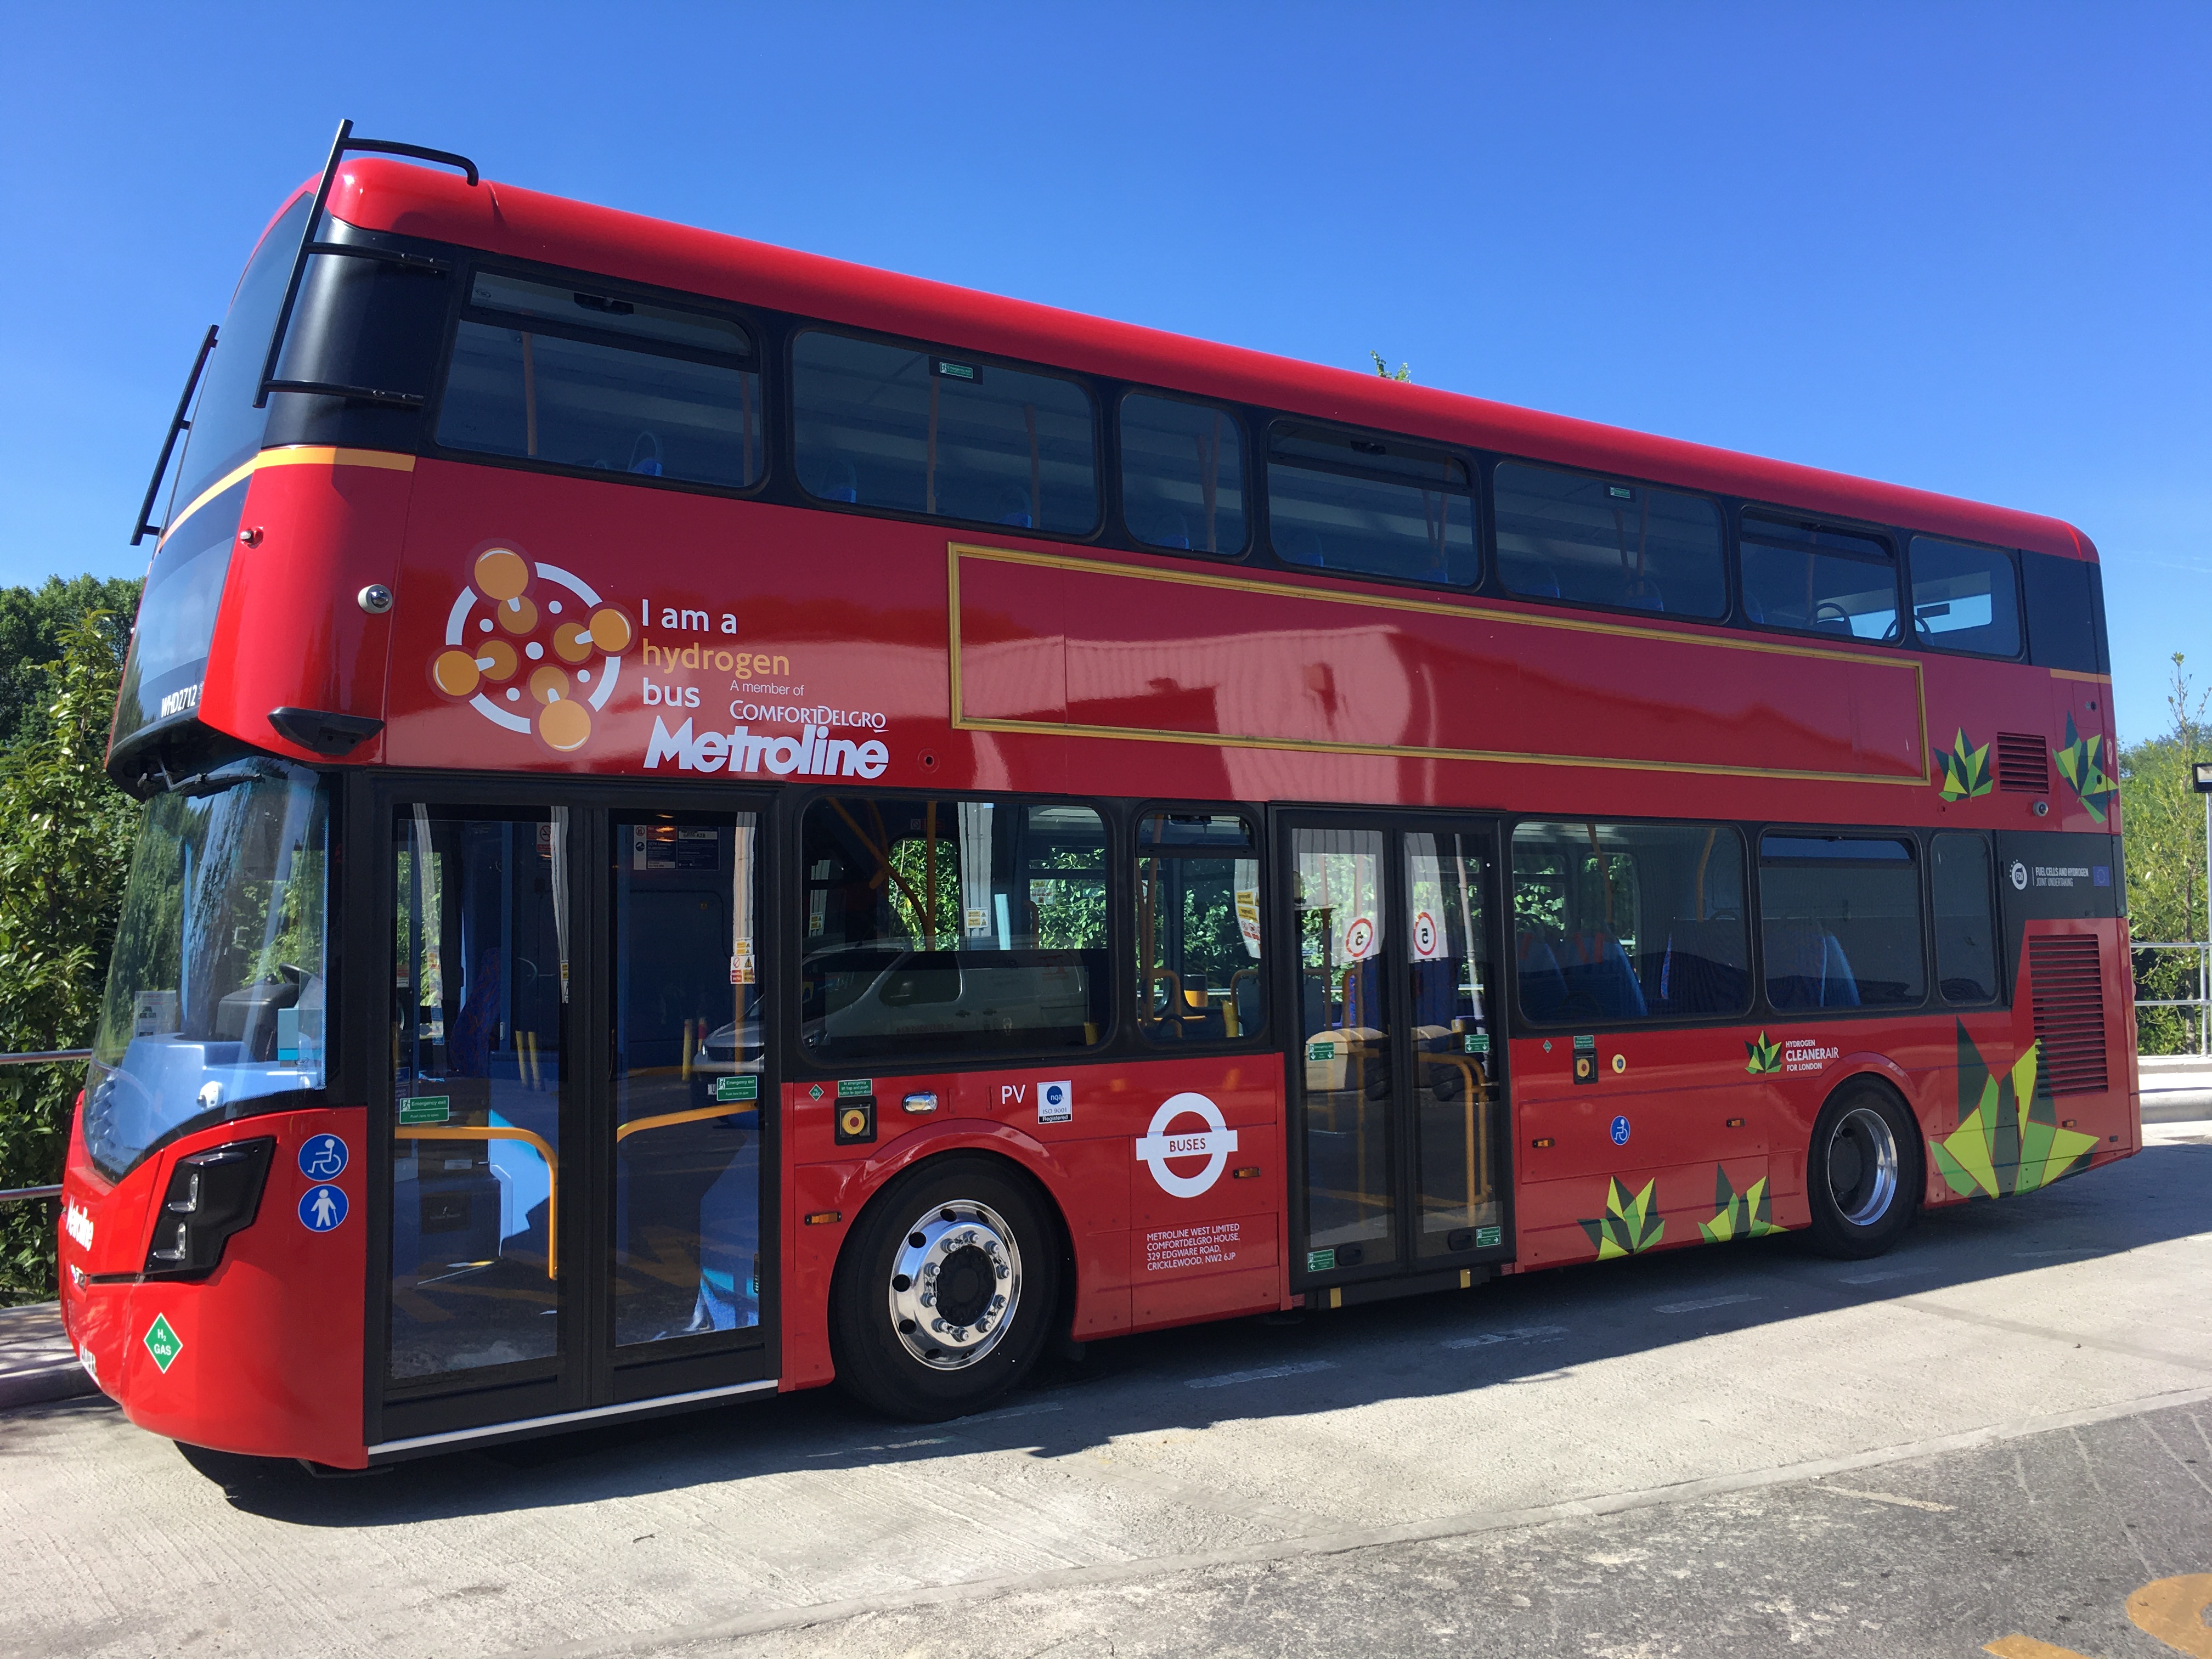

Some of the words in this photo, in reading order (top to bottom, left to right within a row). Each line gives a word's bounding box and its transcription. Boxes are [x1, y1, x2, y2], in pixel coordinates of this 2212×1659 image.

[642, 599, 649, 627] I
[661, 608, 709, 631] am
[721, 613, 737, 634] a
[642, 637, 790, 680] hydrogen
[643, 677, 701, 708] bus
[730, 680, 740, 692] A
[742, 682, 791, 696] member
[793, 685, 805, 696] of
[161, 684, 198, 718] WHD2712
[644, 715, 889, 779] Metroline
[2035, 867, 2046, 876] FUEL
[2046, 867, 2058, 877] CELLS
[2058, 867, 2067, 877] AND
[2067, 868, 2089, 877] HYDROGEN
[2036, 877, 2047, 887] JOINT
[1785, 1039, 1816, 1048] HYDROGEN
[1798, 1062, 1822, 1071] LONDON
[1002, 1084, 1026, 1104] PV
[1170, 1138, 1206, 1152] BUSES
[1147, 1229, 1189, 1242] METROLINE
[1190, 1226, 1210, 1236] WEST
[1211, 1223, 1240, 1234] LIMITED
[1147, 1236, 1212, 1251] COMFORTDELGRO
[1147, 1252, 1160, 1261] 329
[1162, 1247, 1198, 1259] EDGWARE
[1205, 1254, 1222, 1263] NW2
[1223, 1252, 1236, 1261] 6JP
[154, 1343, 172, 1356] GAS
